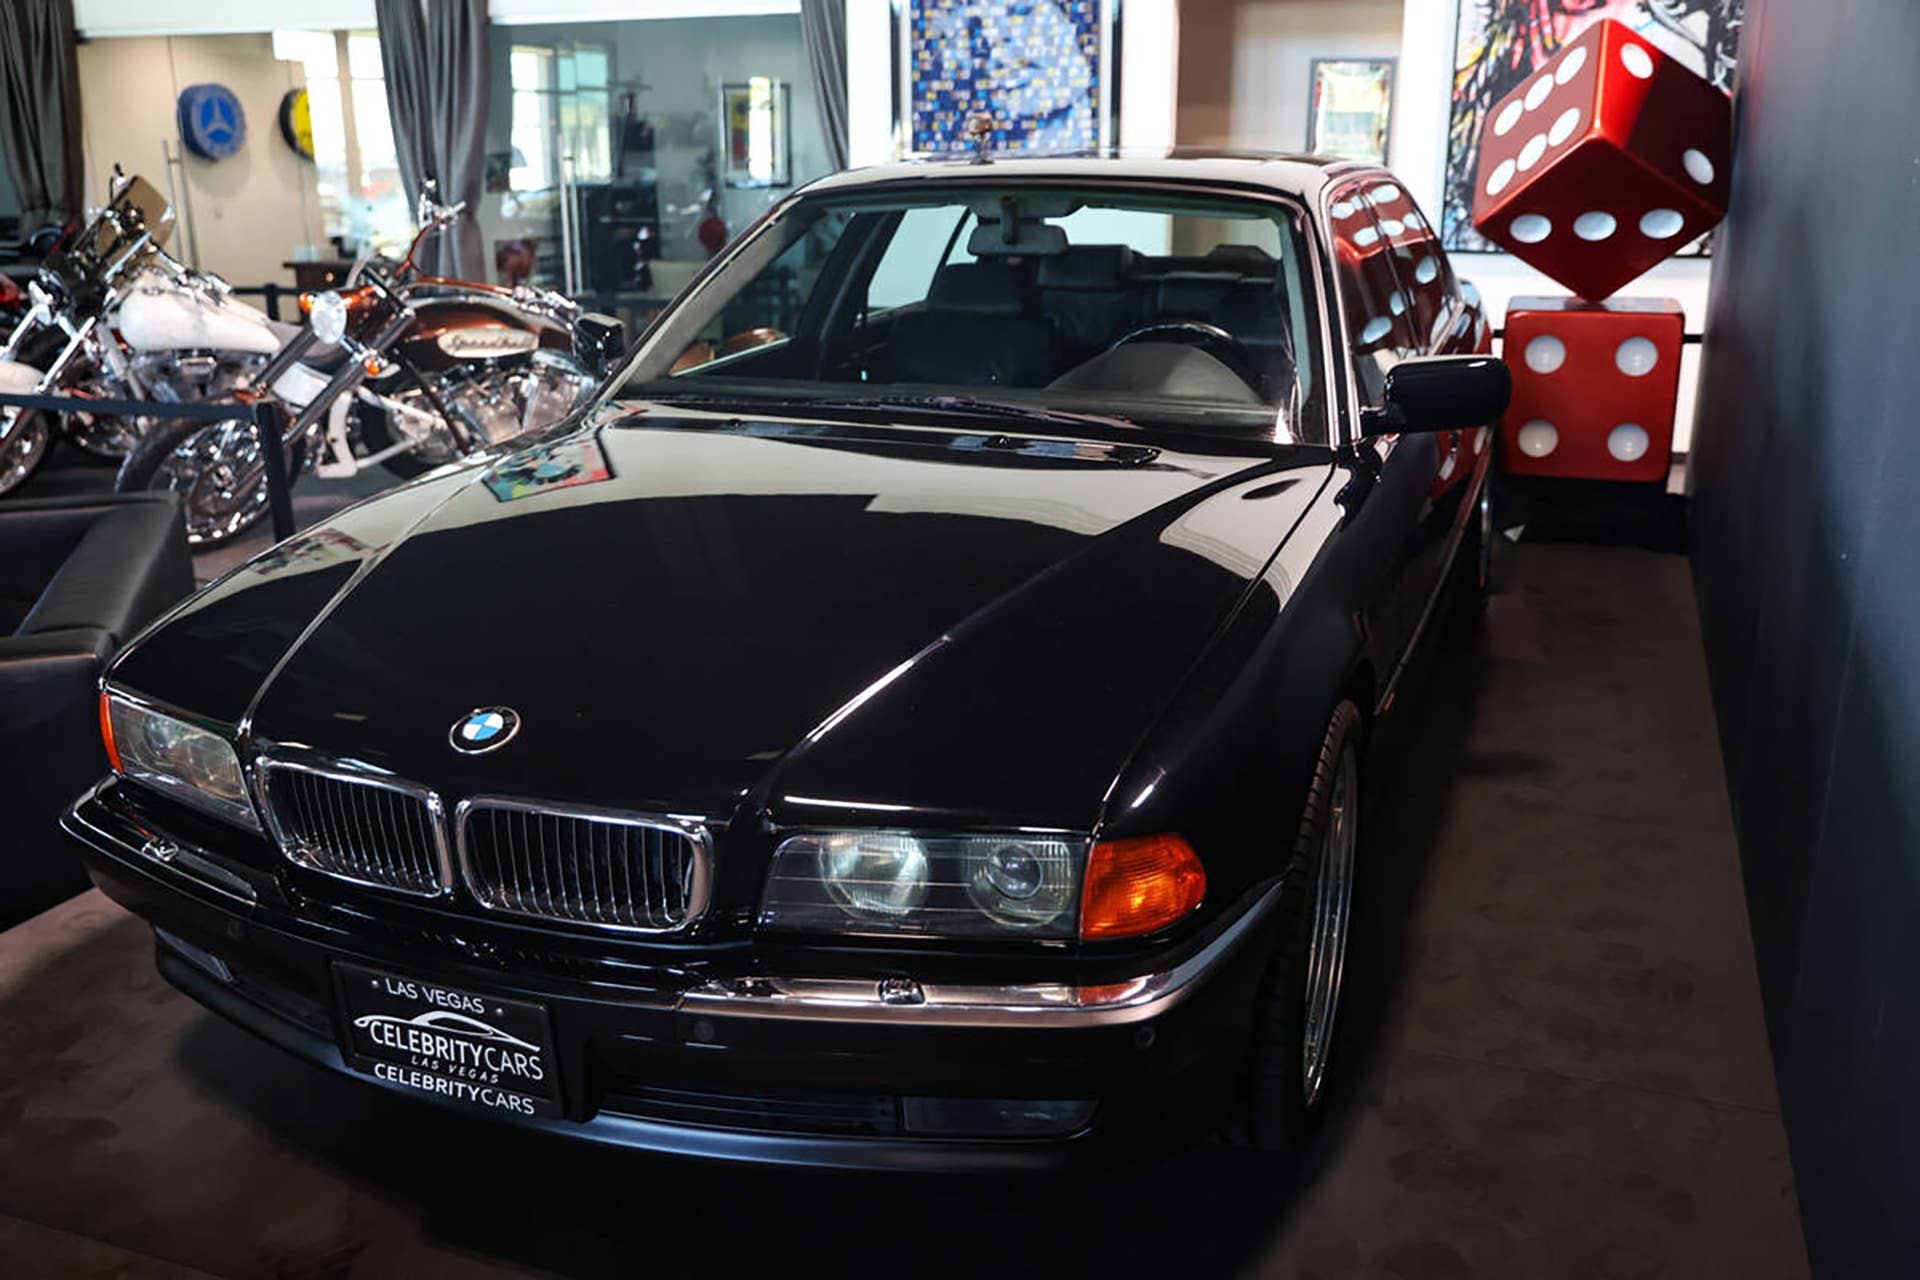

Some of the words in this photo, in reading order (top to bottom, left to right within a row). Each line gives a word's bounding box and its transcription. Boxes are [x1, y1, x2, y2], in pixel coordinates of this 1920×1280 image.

[386, 977, 419, 999] LAS
[422, 986, 485, 1014] VEGAS
[370, 1020, 544, 1081] CELEBRITYCARS
[412, 1055, 439, 1070] LAS
[449, 1064, 499, 1084] VEGAS
[374, 1063, 535, 1115] CELEBRITYCARS
